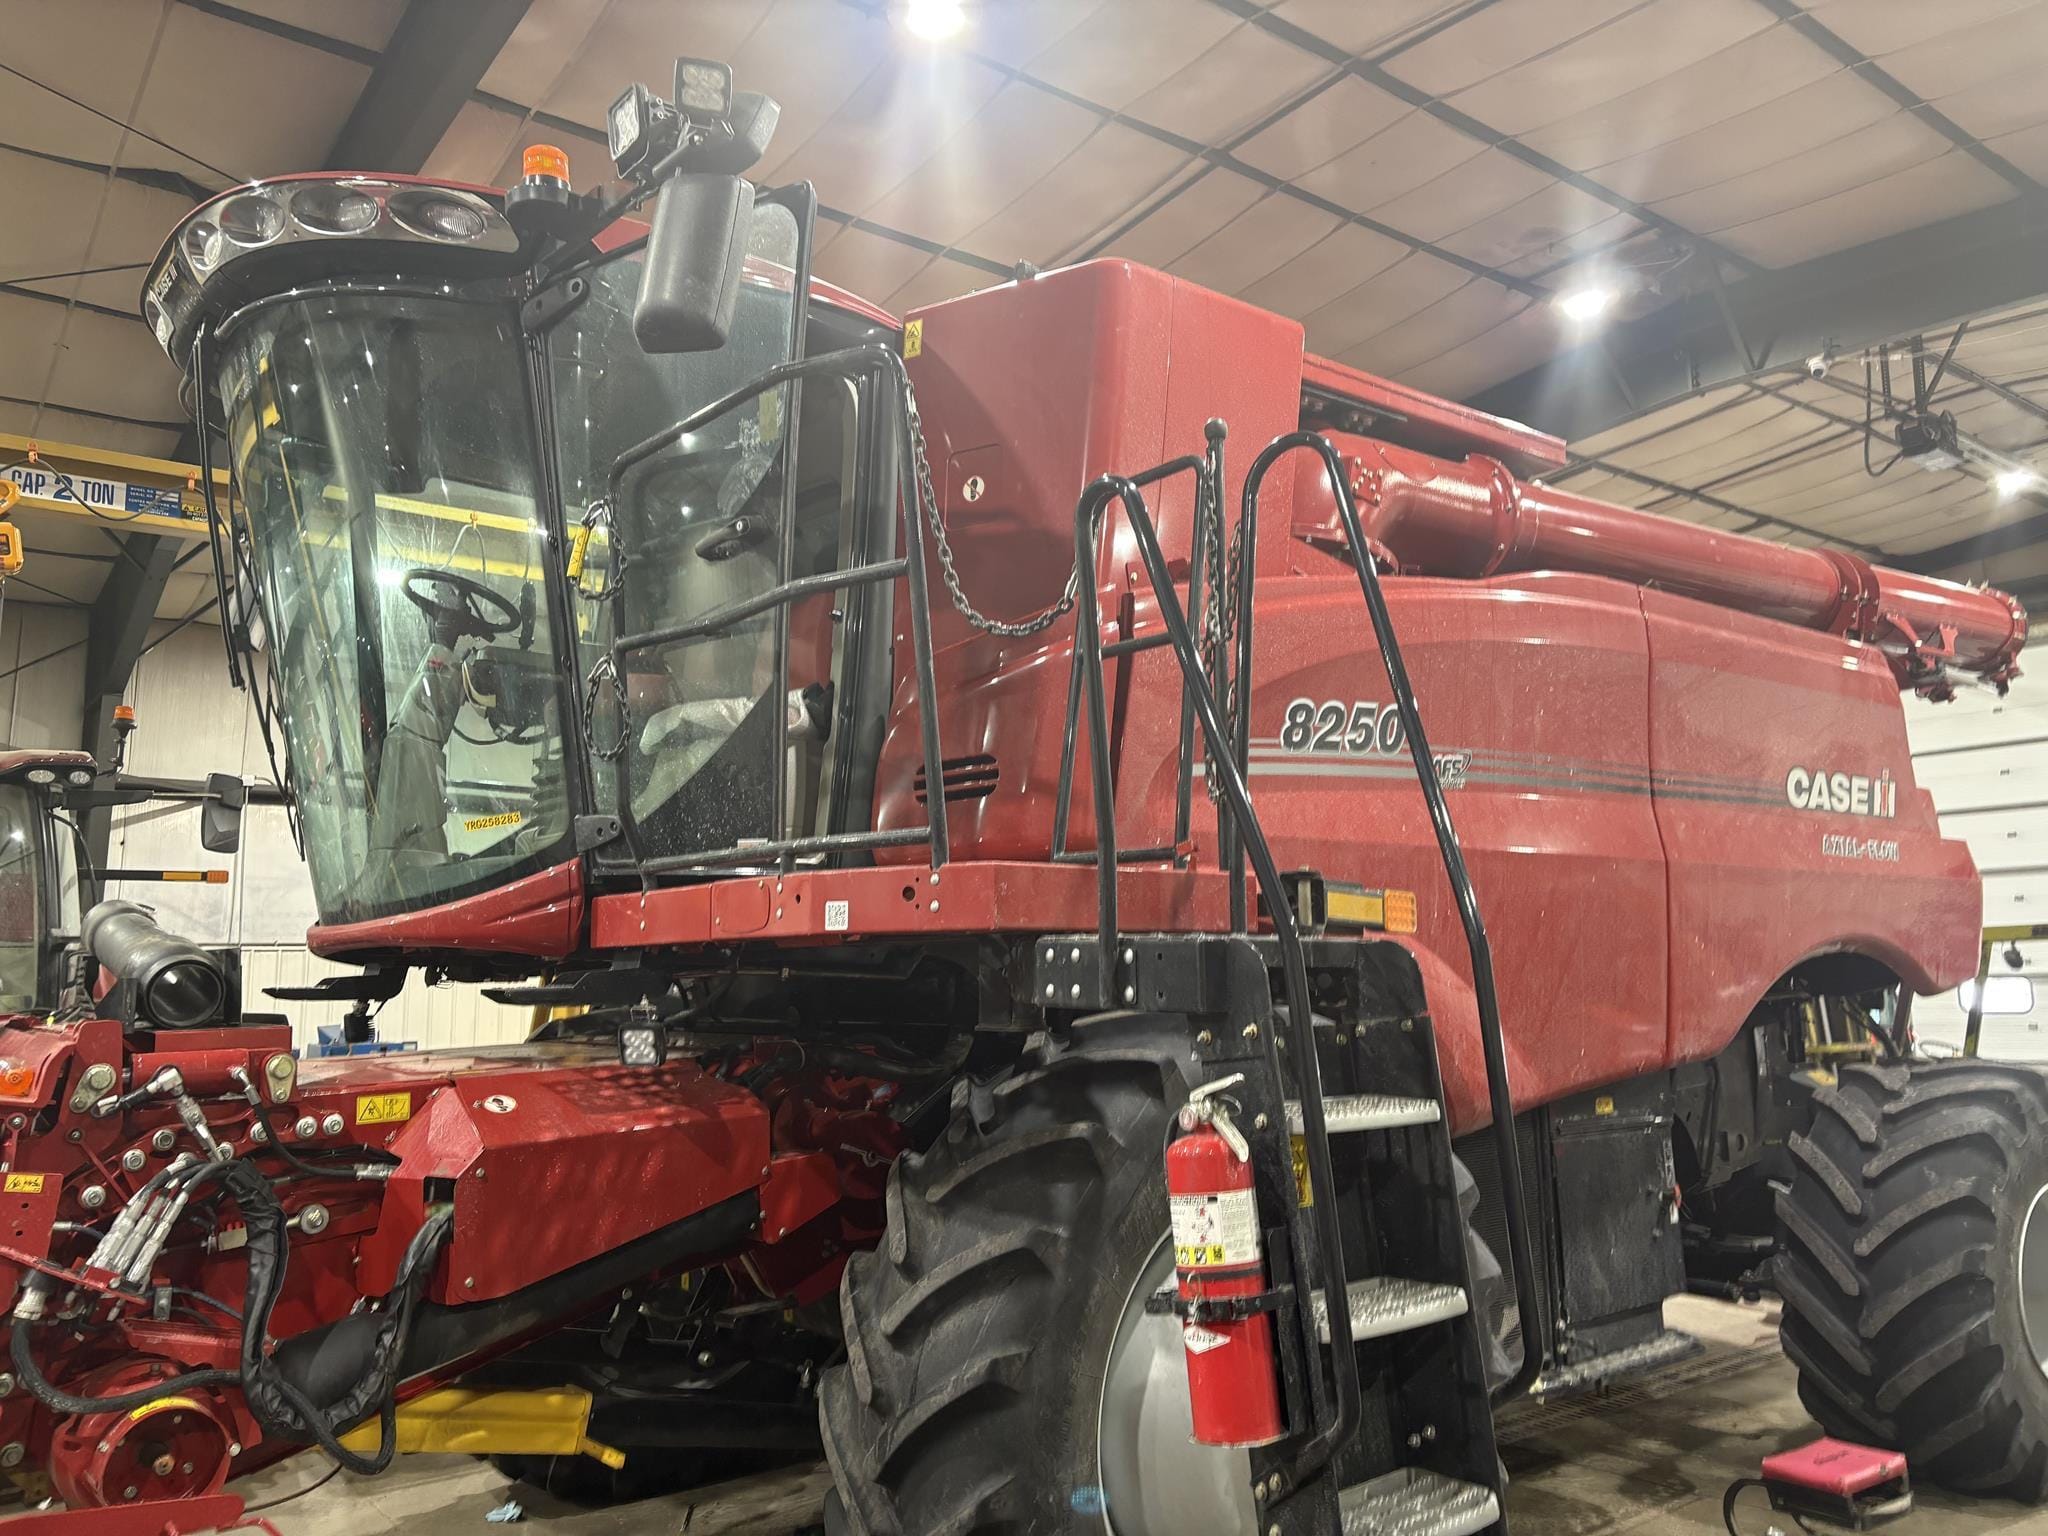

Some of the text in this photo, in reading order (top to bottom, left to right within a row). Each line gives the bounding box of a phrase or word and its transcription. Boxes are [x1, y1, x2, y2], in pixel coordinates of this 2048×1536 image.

[155, 272, 173, 302] CASE
[53, 474, 73, 501] 2
[81, 479, 115, 506] TON
[1281, 697, 1408, 756] 8250
[1786, 766, 1869, 815] CASE
